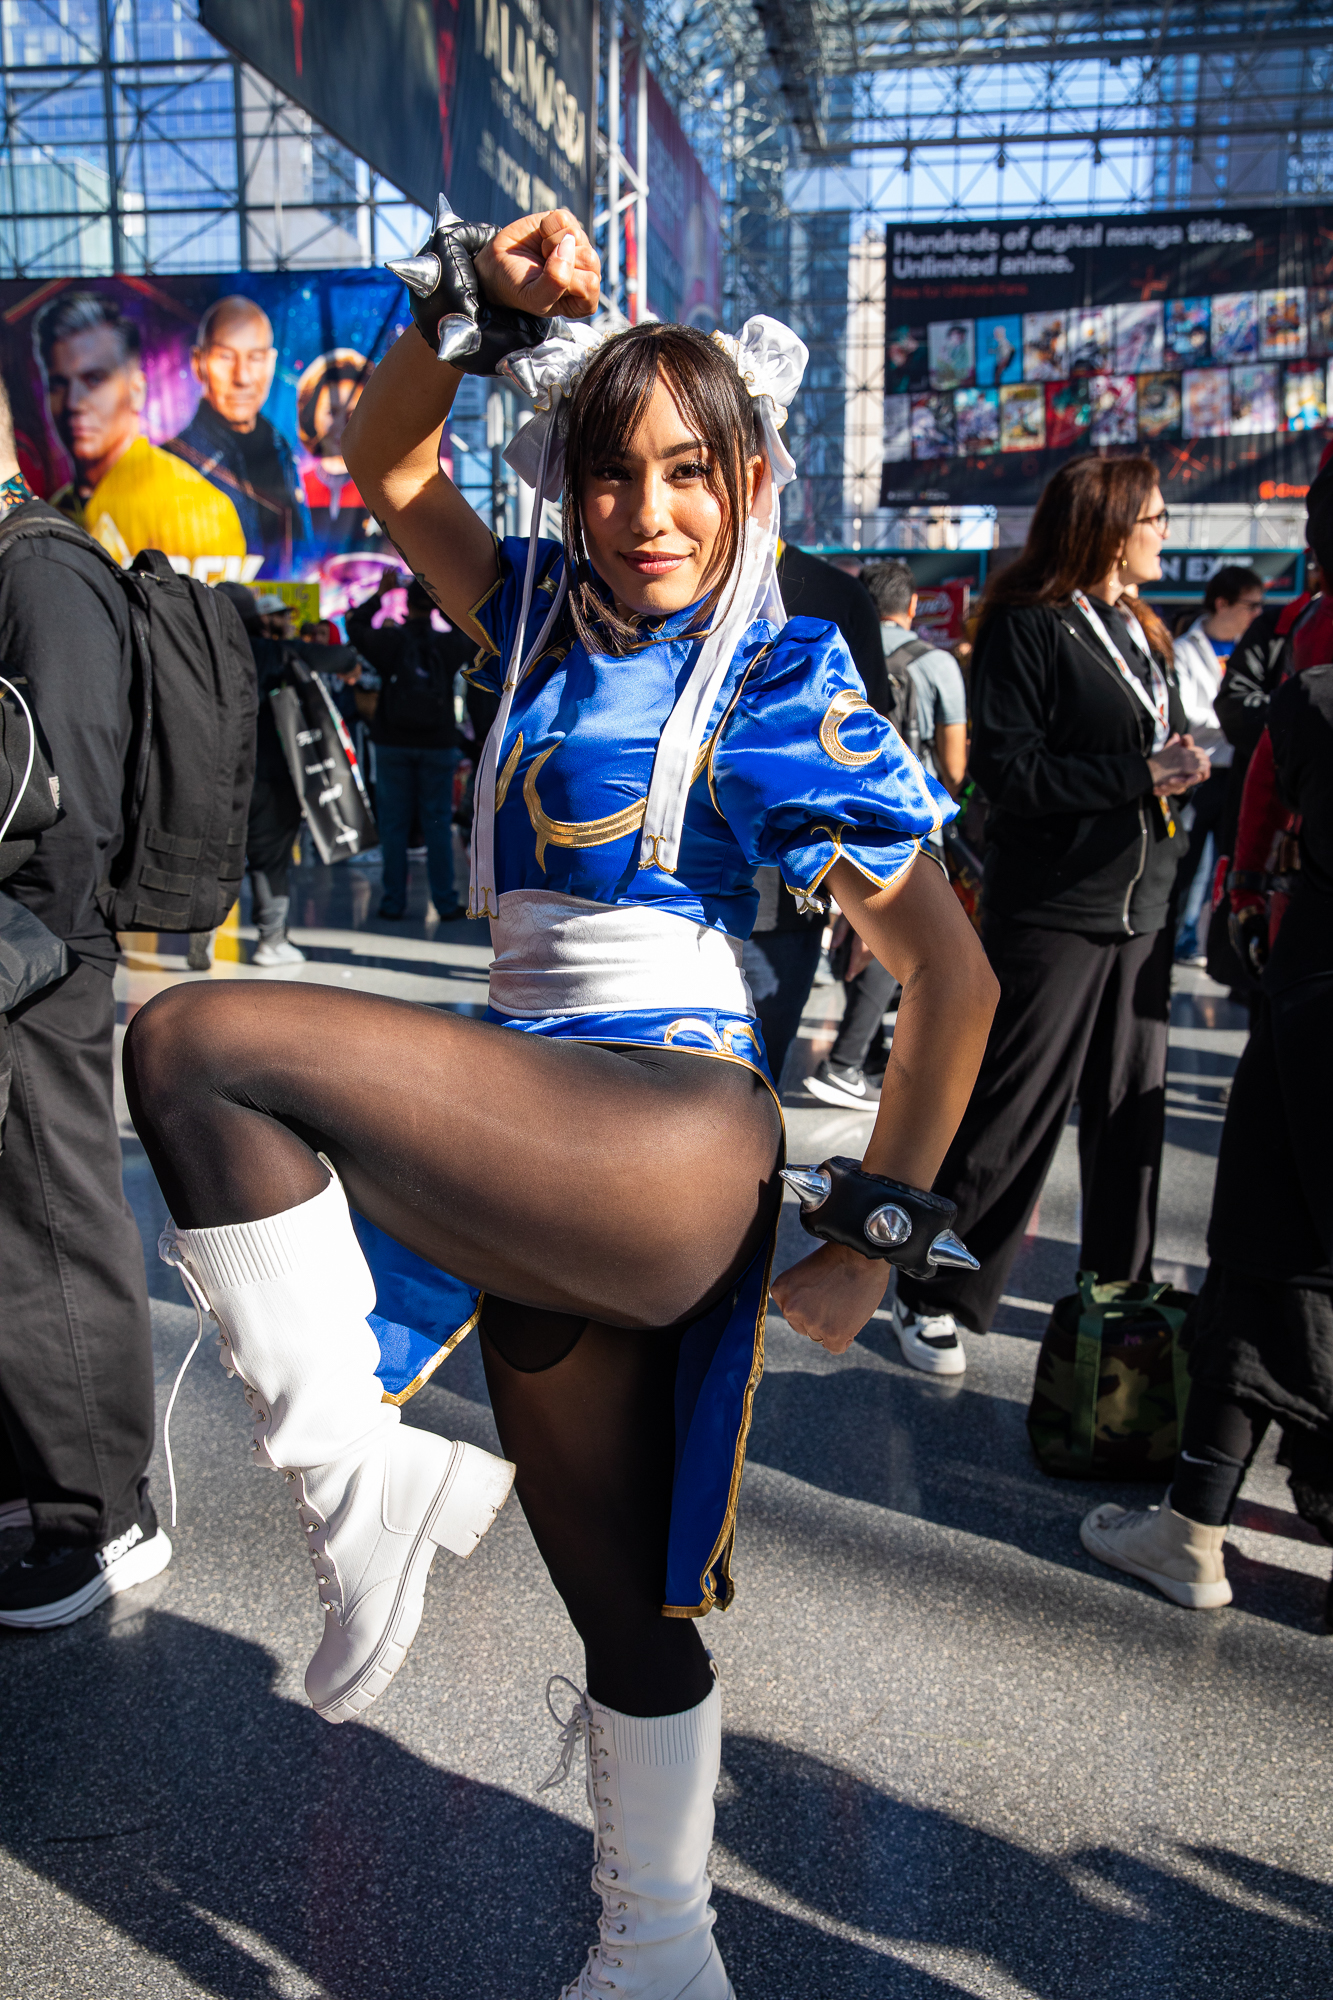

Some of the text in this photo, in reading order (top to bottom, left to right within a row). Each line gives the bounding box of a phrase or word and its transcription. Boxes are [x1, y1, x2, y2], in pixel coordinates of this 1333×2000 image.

[893, 229, 1000, 255] Hundreds
[1002, 225, 1031, 250] of
[1032, 222, 1104, 254] digital
[1105, 225, 1184, 250] manga
[893, 251, 1075, 279] Unlimited anime.
[94, 1522, 144, 1571] HOKA
